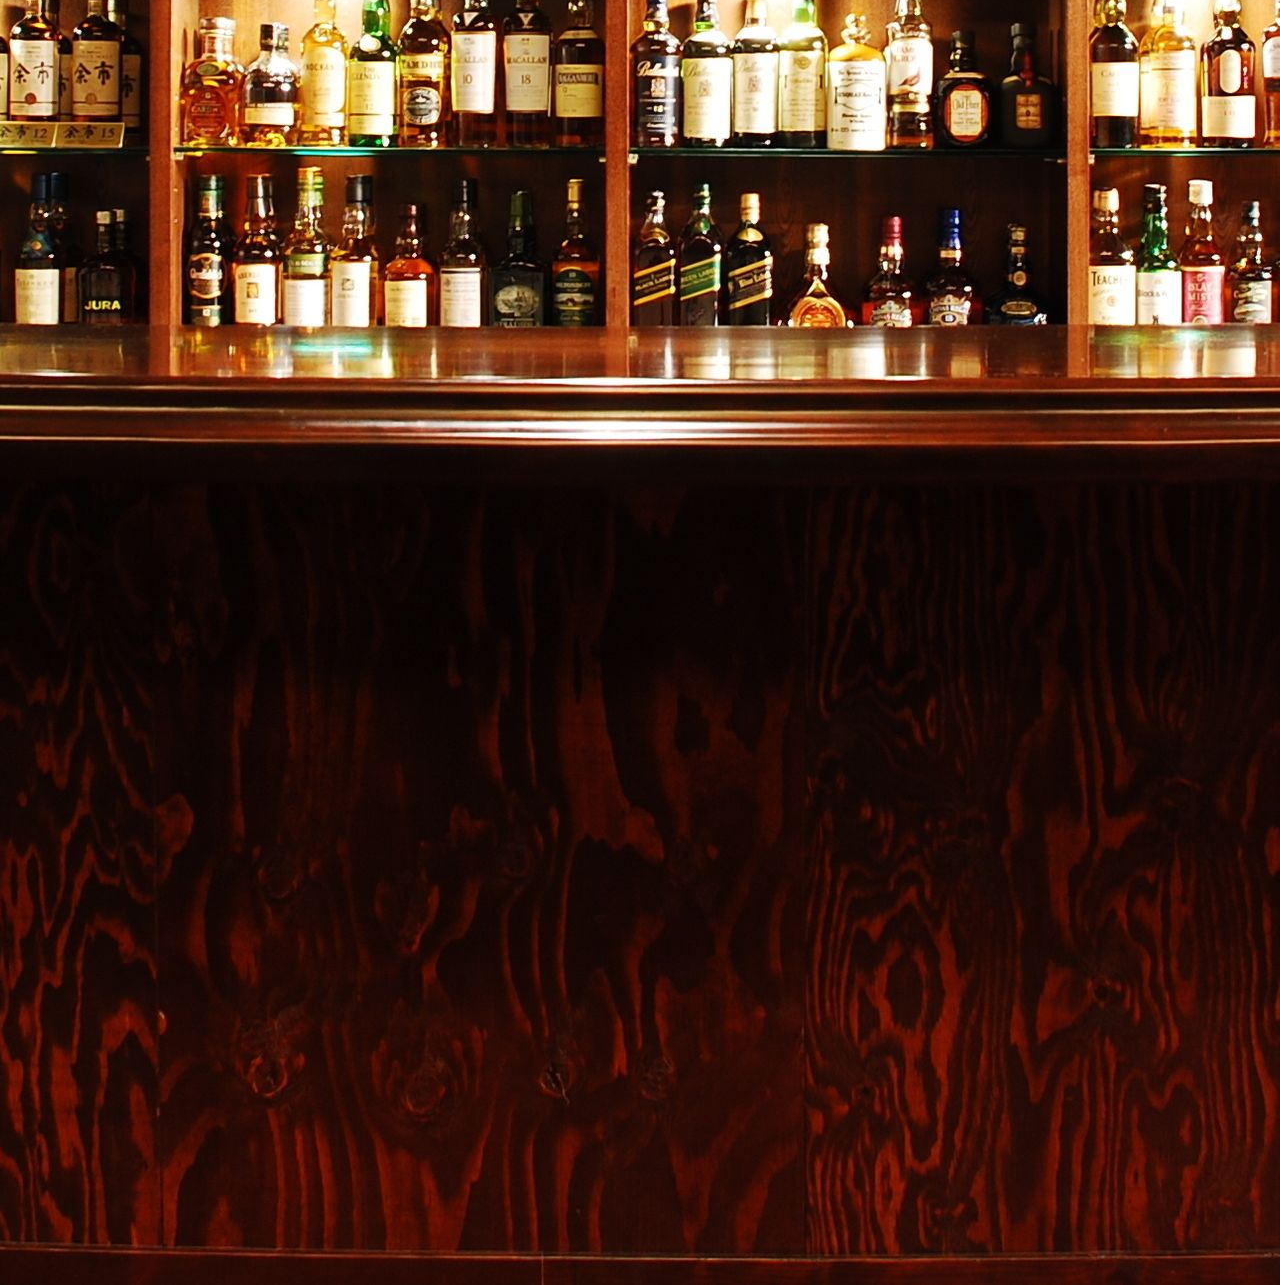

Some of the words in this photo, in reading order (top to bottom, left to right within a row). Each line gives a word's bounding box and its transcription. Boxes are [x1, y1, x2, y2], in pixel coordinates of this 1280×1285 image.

[506, 57, 548, 66] MACALLAN
[13, 62, 53, 85] 余市
[74, 62, 114, 86] 余市
[461, 74, 474, 86] 10
[521, 74, 532, 86] 18
[84, 300, 120, 310] JURA
